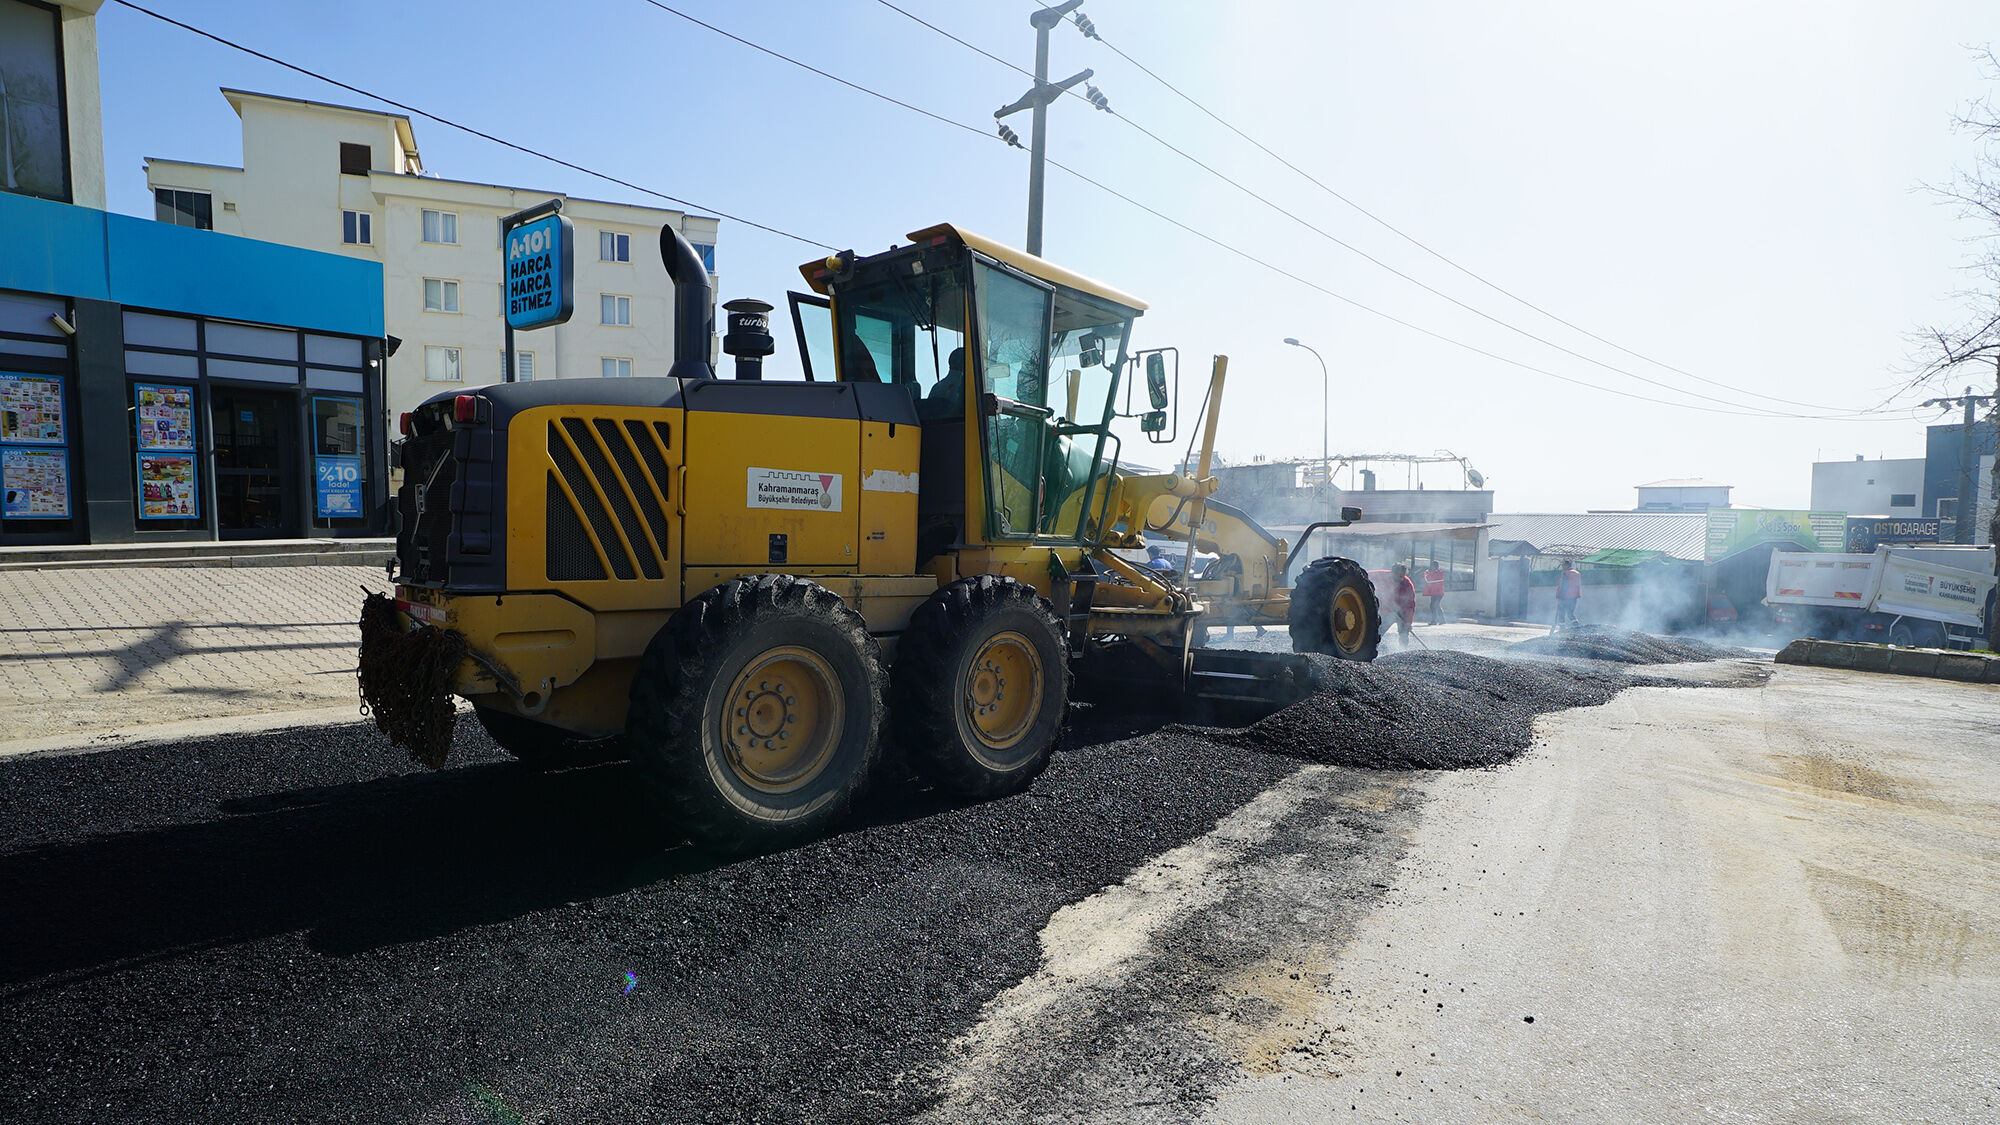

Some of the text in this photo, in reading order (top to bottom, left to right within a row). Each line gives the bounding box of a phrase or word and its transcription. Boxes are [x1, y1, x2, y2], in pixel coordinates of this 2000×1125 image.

[511, 253, 552, 280] HARCA
[511, 272, 552, 298] HARCA
[739, 317, 767, 328] turbo
[319, 465, 358, 482] %10
[758, 482, 819, 497] Kahramanmaraş
[758, 493, 819, 506] Büyükşehir Belediyesi
[1874, 522, 1938, 535] OSTOGARAGE
